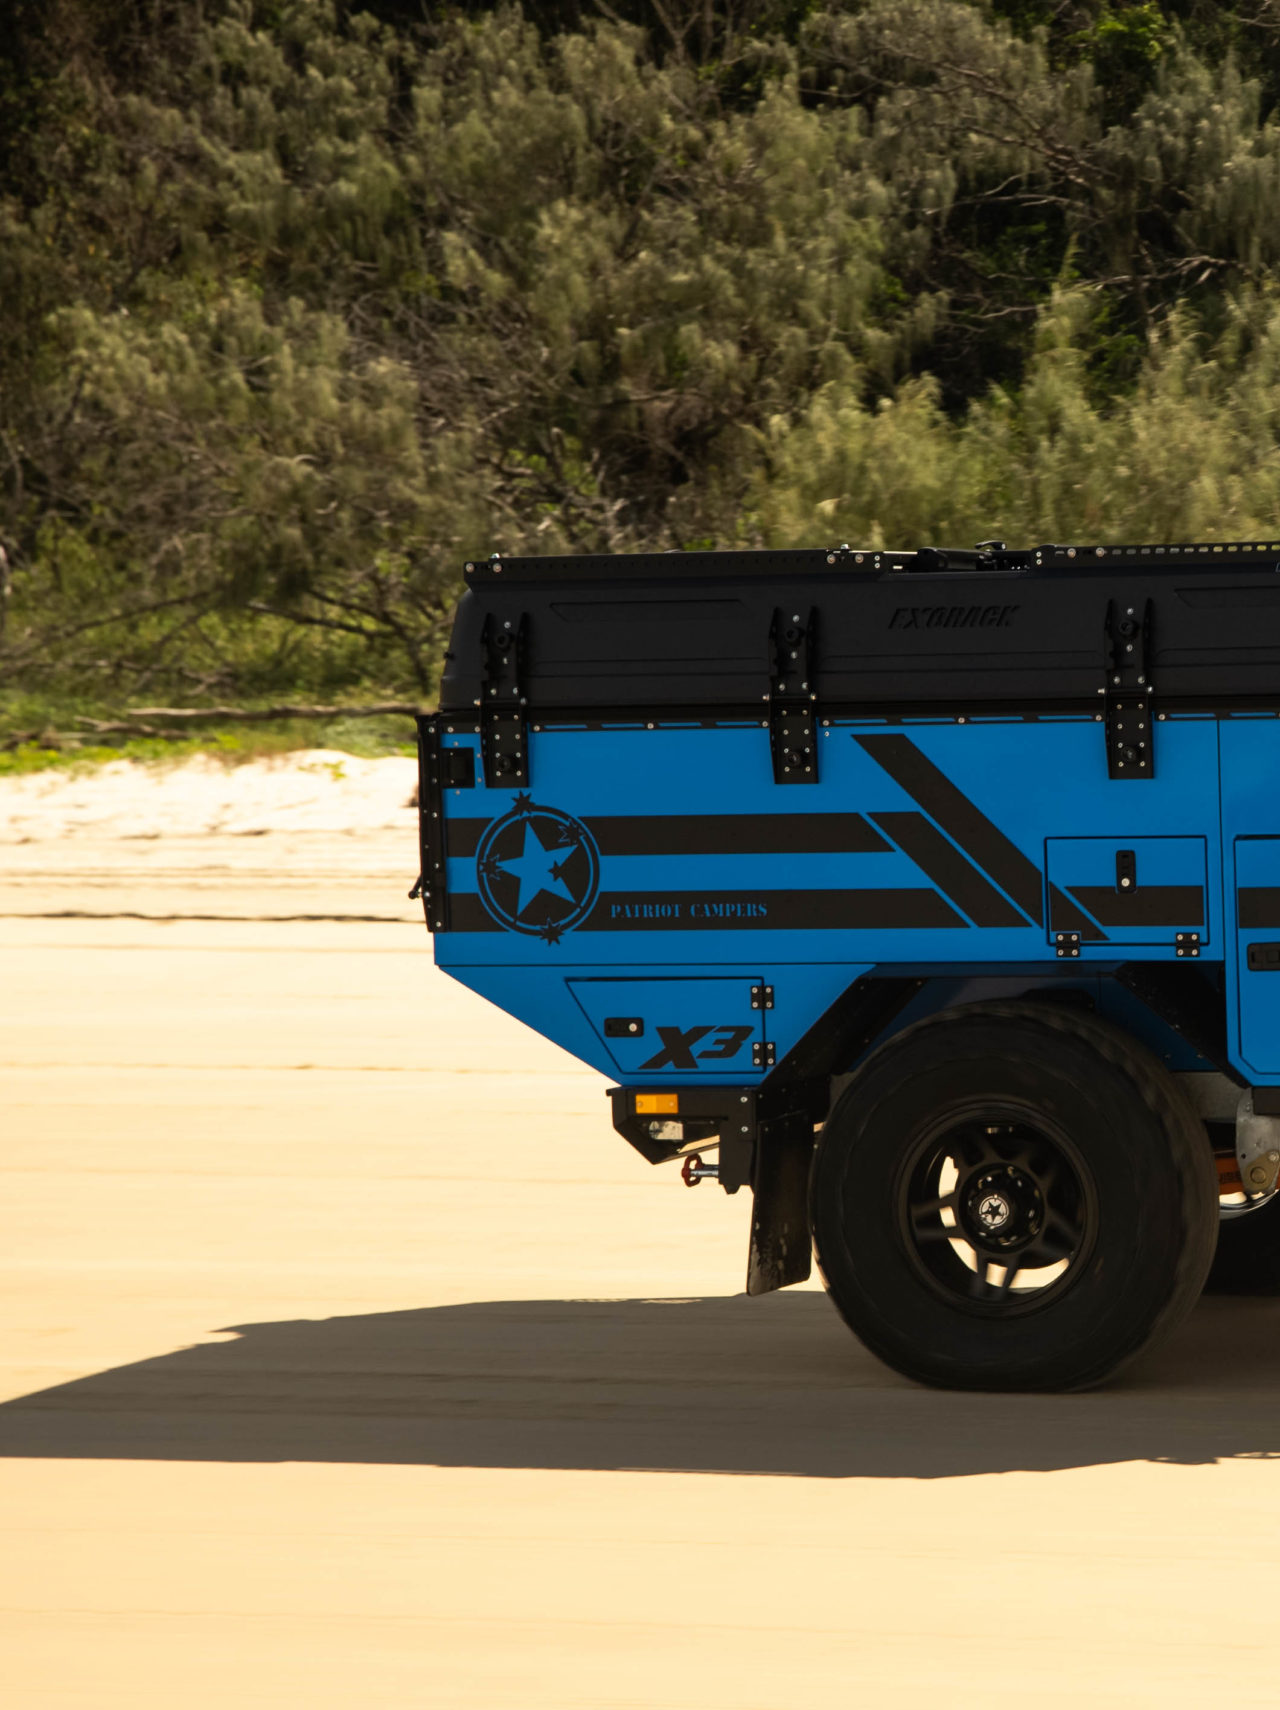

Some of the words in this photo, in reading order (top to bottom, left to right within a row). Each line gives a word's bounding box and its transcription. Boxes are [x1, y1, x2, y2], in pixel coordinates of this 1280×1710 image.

[610, 903, 681, 918] PATRIOT
[690, 902, 768, 918] CAMPERS
[637, 1025, 755, 1070] X3
